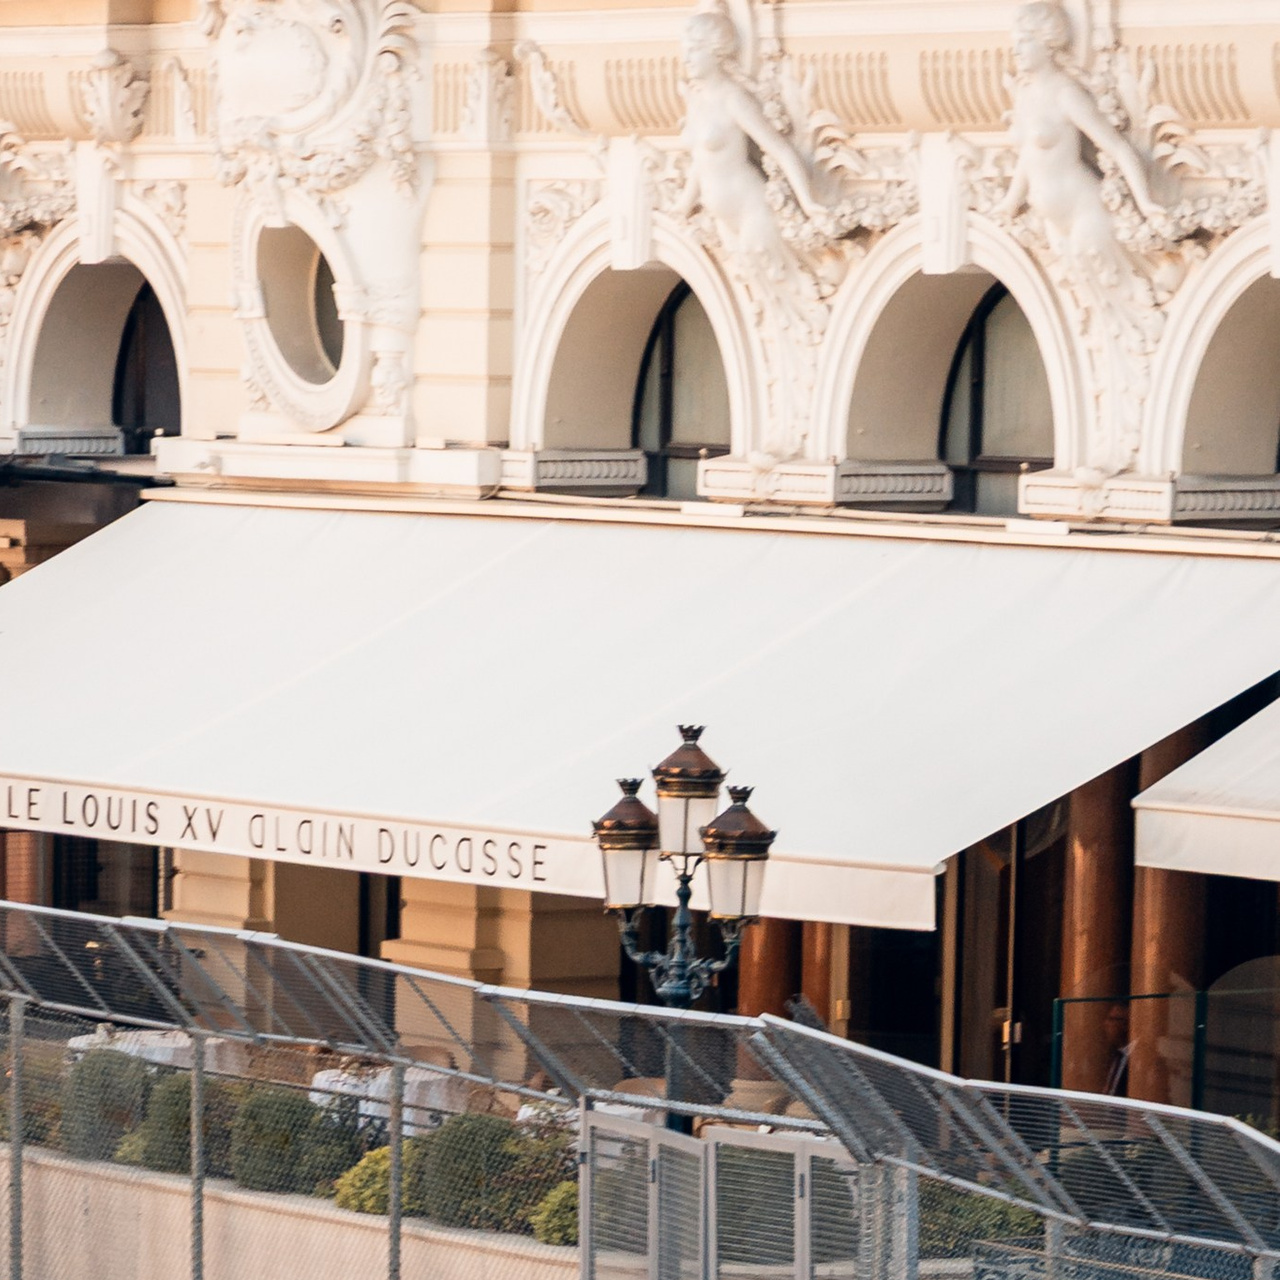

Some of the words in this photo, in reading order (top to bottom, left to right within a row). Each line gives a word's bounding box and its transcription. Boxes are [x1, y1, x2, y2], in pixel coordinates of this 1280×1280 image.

[7, 786, 40, 820] LE
[62, 791, 160, 836] LOUIS
[180, 805, 224, 842] XV
